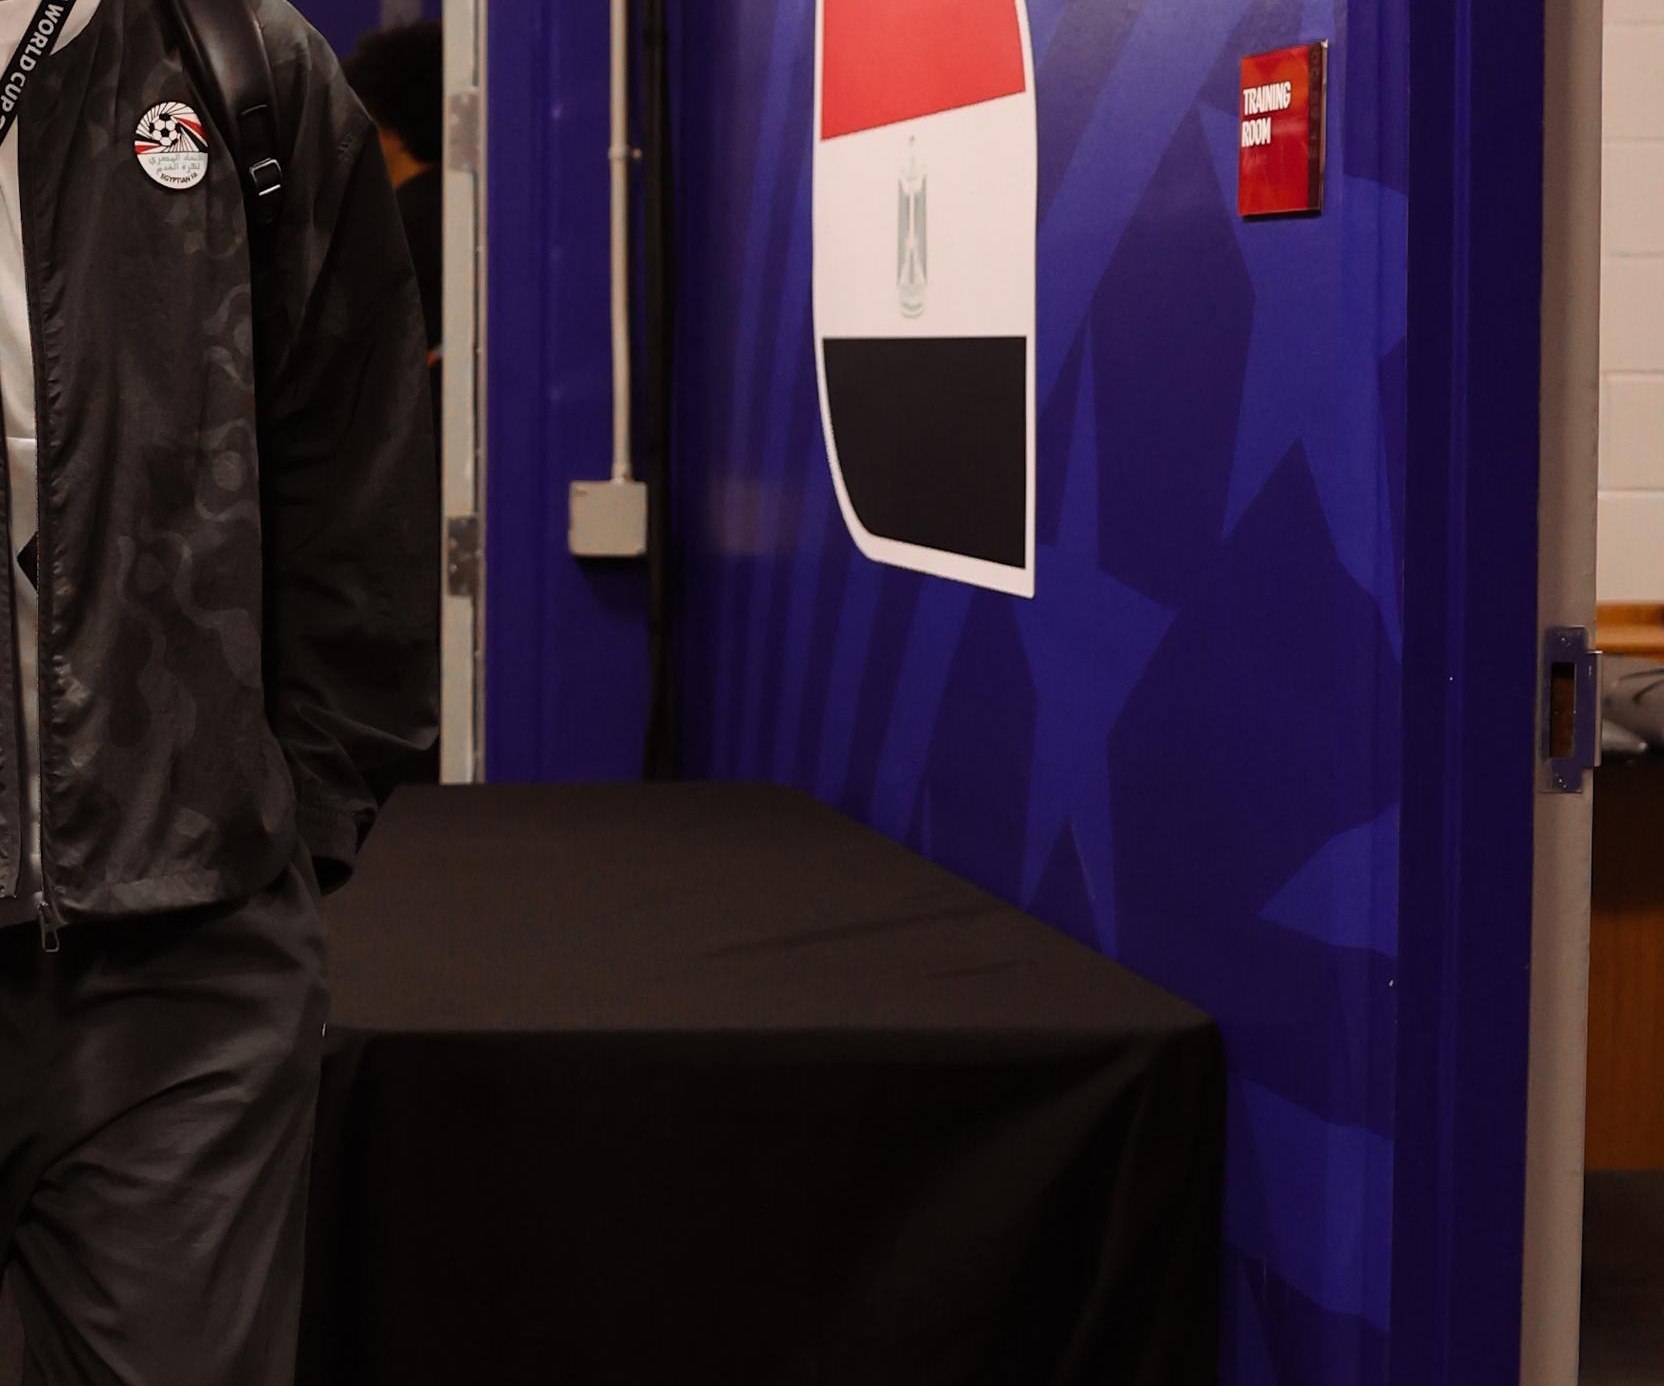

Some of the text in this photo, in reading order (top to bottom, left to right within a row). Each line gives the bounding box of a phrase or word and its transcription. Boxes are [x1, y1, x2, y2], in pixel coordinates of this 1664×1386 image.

[19, 6, 65, 72] WORLD
[0, 71, 26, 113] CUP
[1243, 81, 1292, 116] TRAINING
[1241, 117, 1272, 148] ROOM
